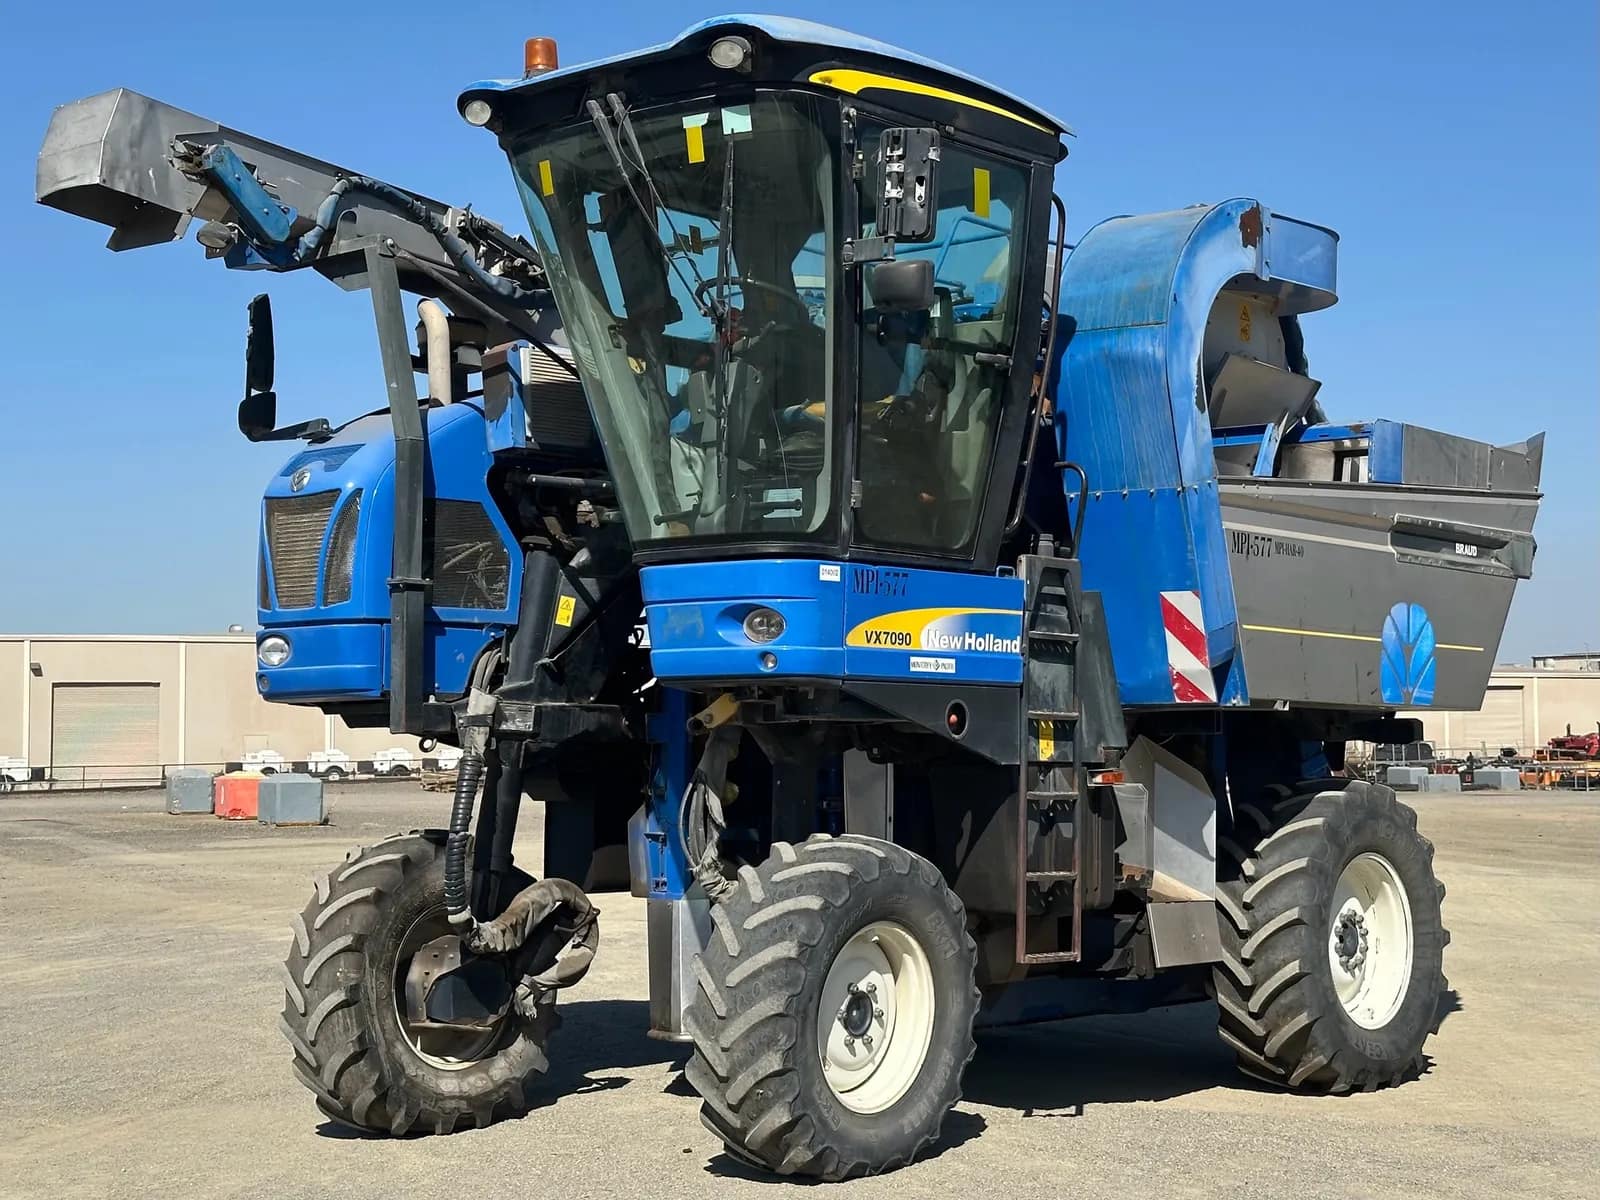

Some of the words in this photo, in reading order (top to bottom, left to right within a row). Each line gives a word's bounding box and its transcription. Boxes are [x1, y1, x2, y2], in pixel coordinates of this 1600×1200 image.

[1455, 542, 1478, 557] BRAUD
[865, 630, 912, 646] VX7090
[926, 629, 963, 650] New
[964, 632, 1021, 653] Holland
